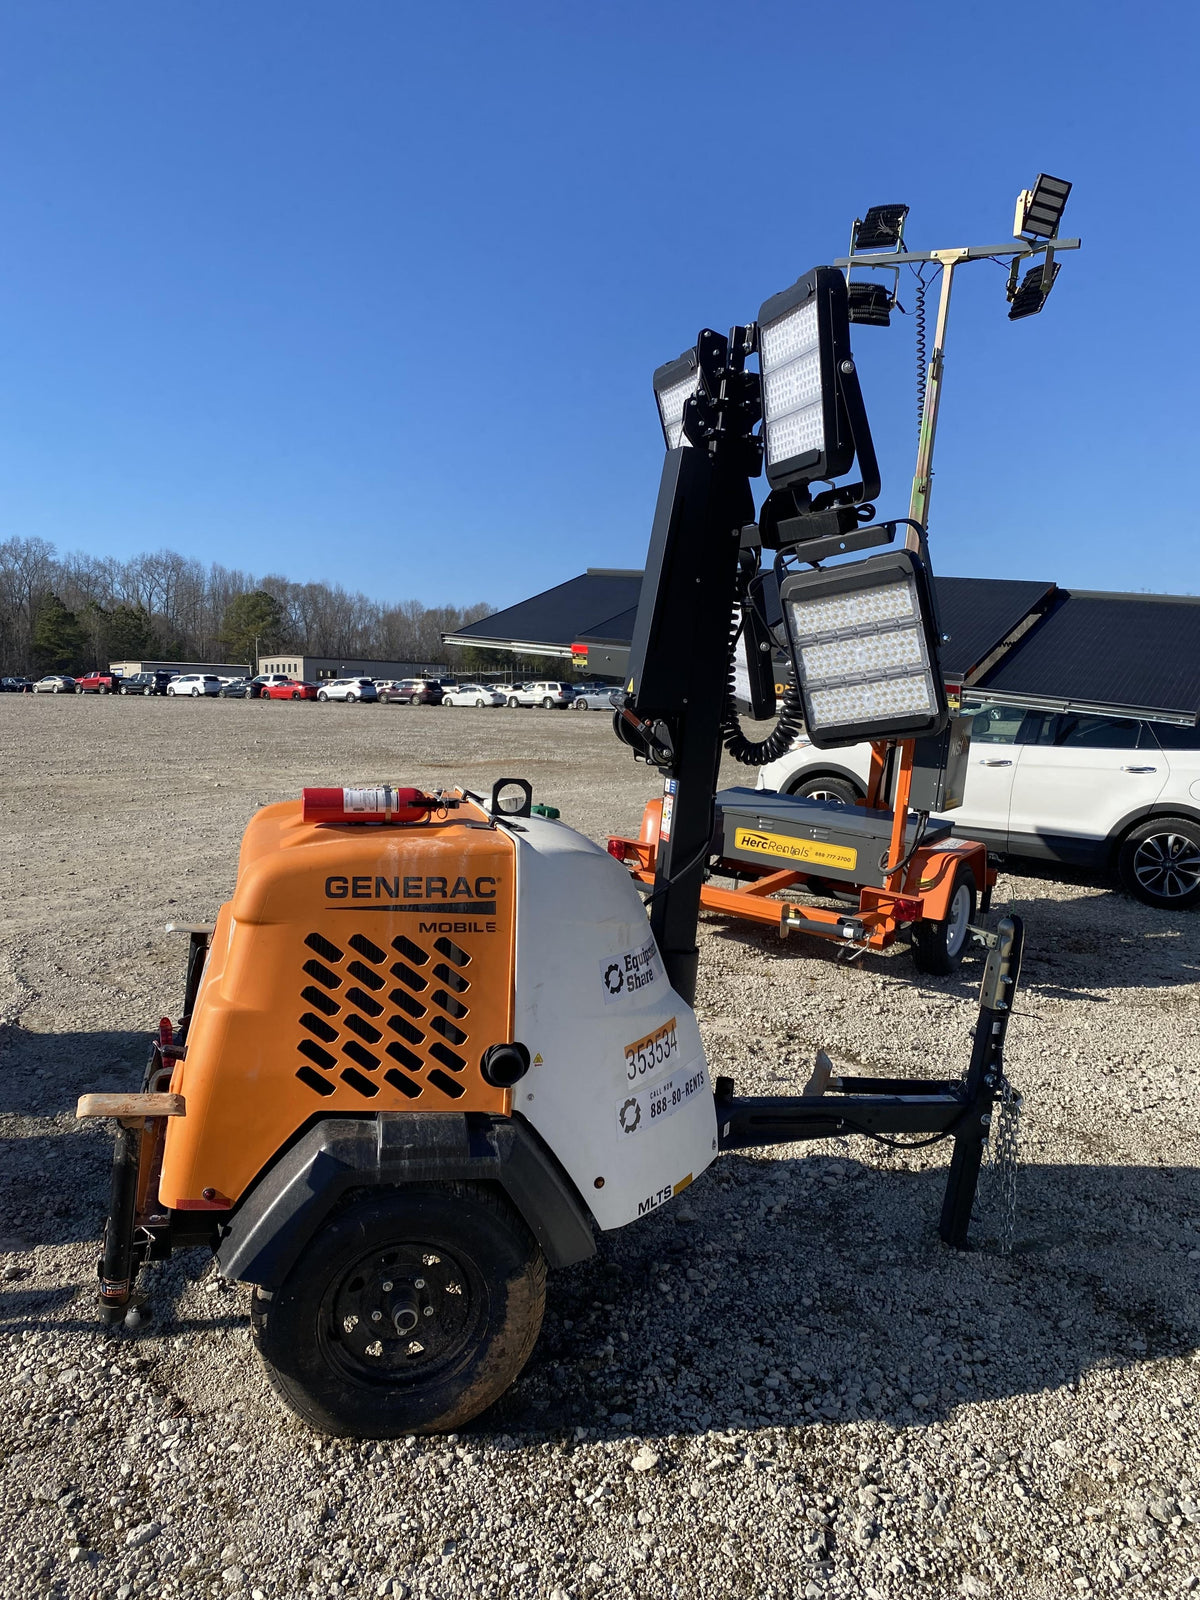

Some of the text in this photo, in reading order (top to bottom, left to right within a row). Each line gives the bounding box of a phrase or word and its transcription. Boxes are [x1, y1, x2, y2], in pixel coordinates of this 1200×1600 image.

[325, 876, 497, 898] GENERAC
[419, 922, 497, 934] MOBILE
[626, 969, 654, 993] Share
[625, 1022, 678, 1081] 353534
[649, 1081, 673, 1099] CALL NOW
[650, 1070, 705, 1119] 888-80-RENTS
[637, 1184, 672, 1216] MLTS
